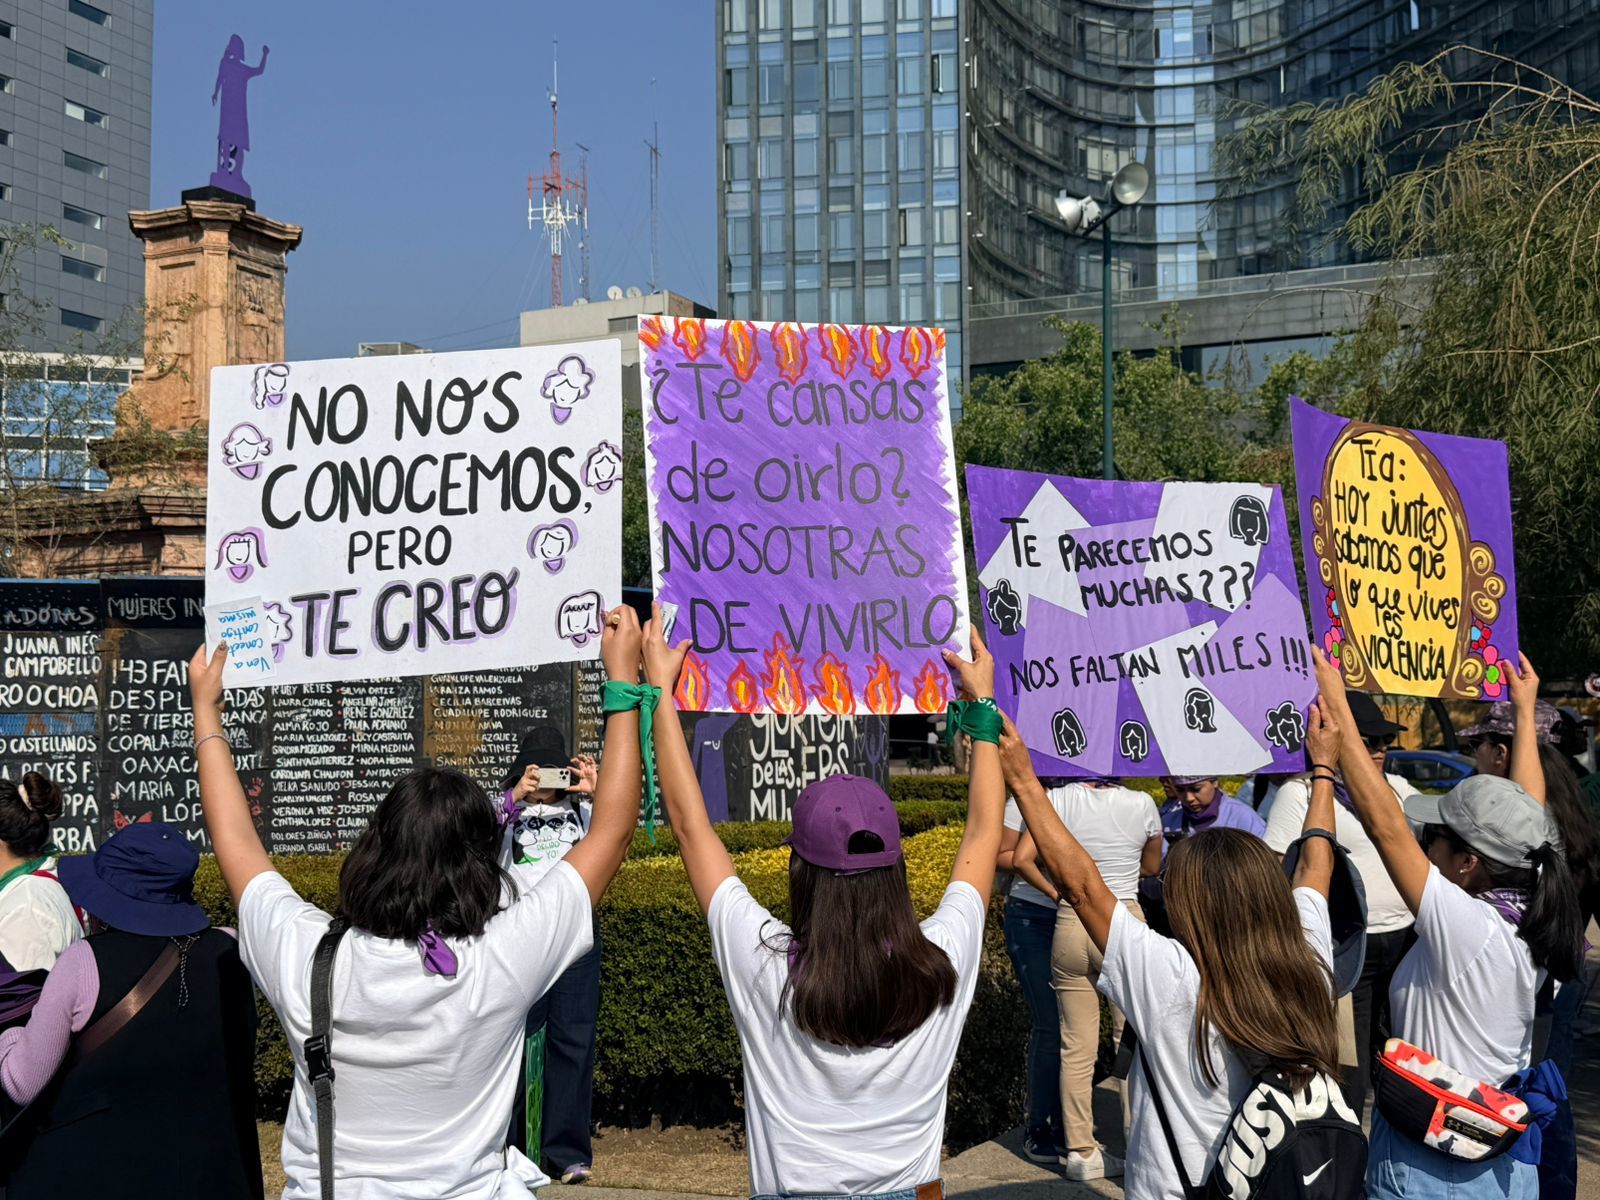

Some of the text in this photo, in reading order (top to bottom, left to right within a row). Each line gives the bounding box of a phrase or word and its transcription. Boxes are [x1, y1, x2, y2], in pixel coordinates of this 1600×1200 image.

[652, 360, 926, 427] ¿Te cansas
[287, 371, 522, 450] NO NOS
[667, 441, 910, 506] de oirlo?
[261, 446, 592, 529] CONOCEMOS,
[1335, 480, 1447, 550] HOY juntas
[348, 525, 452, 574] PERO
[662, 521, 926, 580] NOSOTRAS
[1000, 518, 1212, 573] TE PARECEMOS
[1334, 526, 1445, 589] sabemos que
[1080, 562, 1255, 610] MUCHAS???
[1345, 569, 1460, 629] lo que vives
[108, 594, 204, 620] MUJERES IN
[290, 567, 519, 658] TE CREO
[690, 598, 758, 654] DE
[779, 594, 957, 654] VIVIRLO
[1383, 610, 1403, 640] es
[4, 632, 60, 655] JUANA
[5, 656, 101, 678] CAMPOBELLO
[234, 661, 243, 669] a
[1361, 633, 1447, 681] VIOLENCIA
[112, 659, 147, 685] 143
[1010, 656, 1059, 695] NOS
[1070, 647, 1160, 688] FALTAN
[26, 684, 98, 708] OCHOA
[271, 684, 298, 696] RUBY
[368, 686, 395, 695] ORTIZ
[473, 686, 503, 695] RAMOS
[108, 714, 131, 728] DE
[139, 713, 194, 731] TIERR
[302, 720, 330, 731] ROJO
[370, 706, 416, 719] GONZALEZ
[493, 708, 548, 719] RODRIGUEZ
[10, 735, 97, 755] CASTELLANOS
[108, 733, 169, 753] COPALA
[381, 743, 416, 753] MEDINA
[115, 774, 175, 800] MARÍA
[348, 792, 376, 802] ROSA
[162, 797, 203, 822] LÓP
